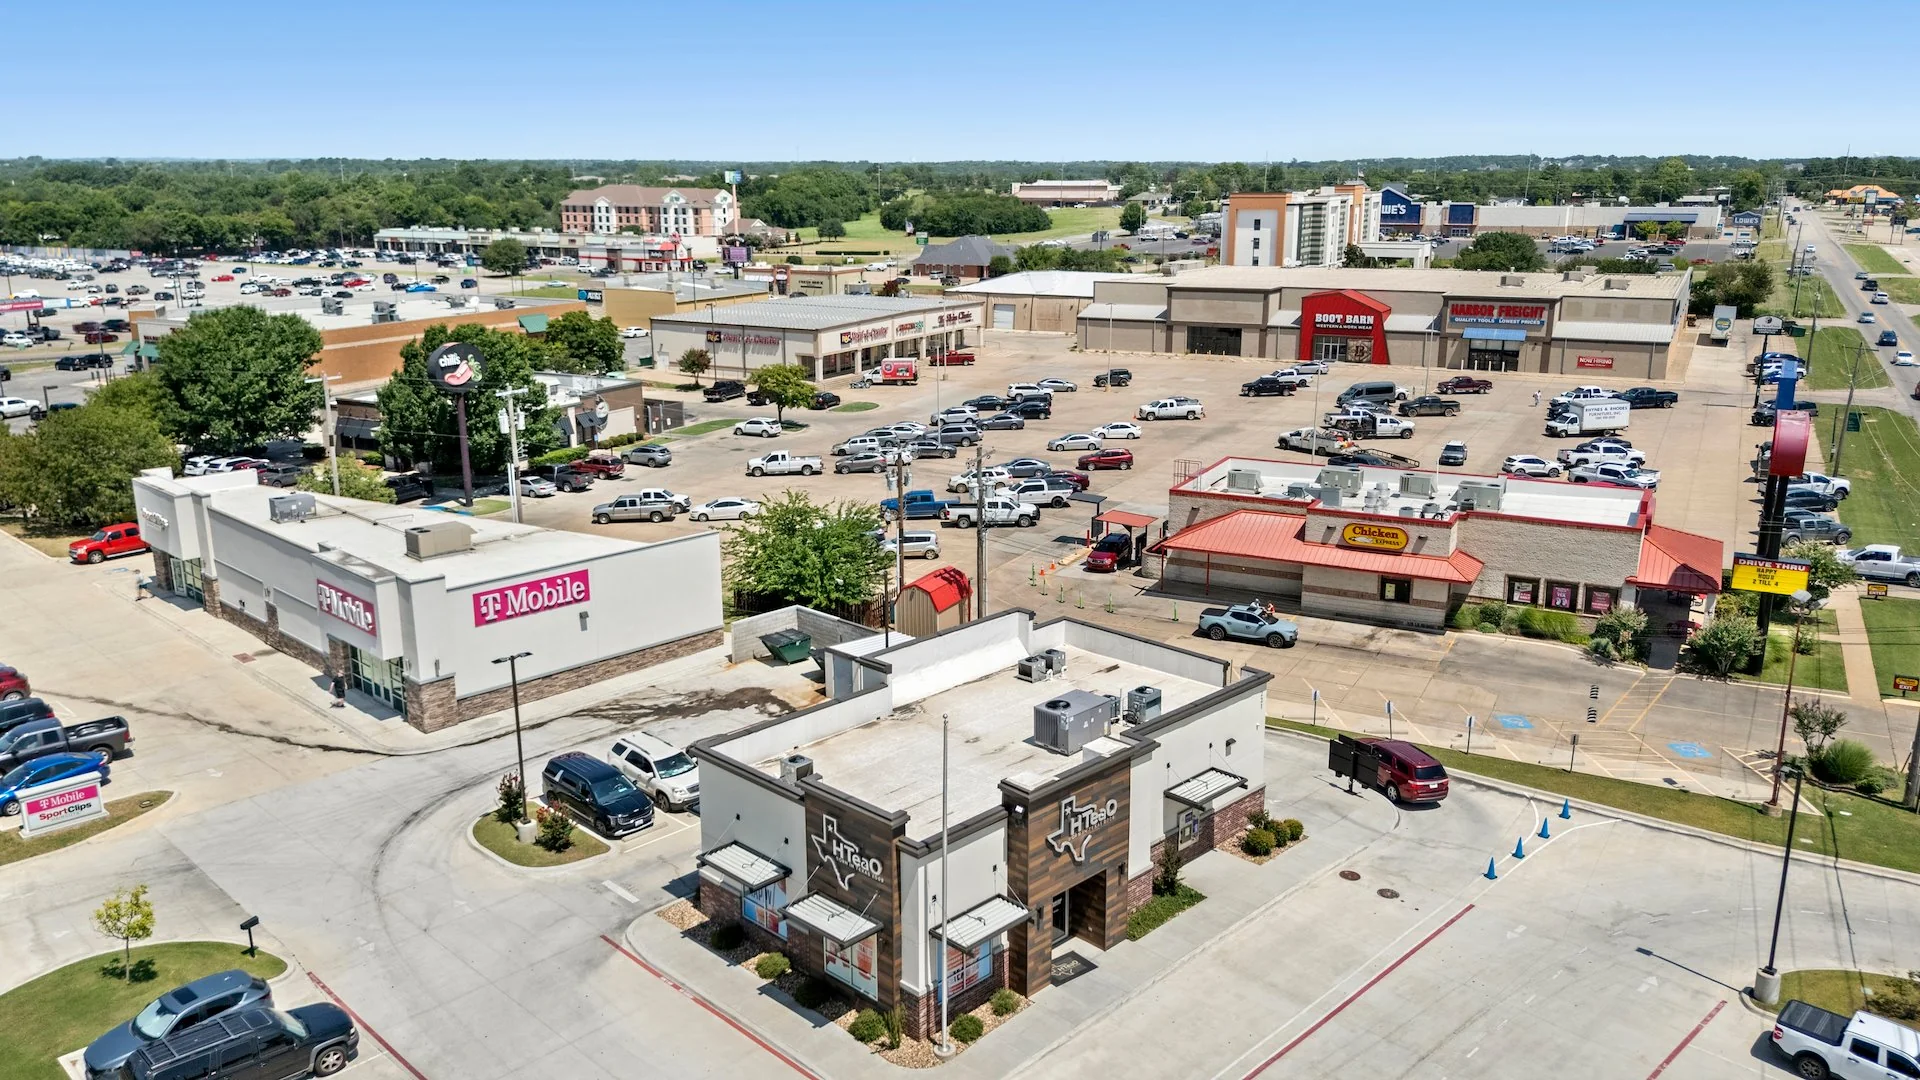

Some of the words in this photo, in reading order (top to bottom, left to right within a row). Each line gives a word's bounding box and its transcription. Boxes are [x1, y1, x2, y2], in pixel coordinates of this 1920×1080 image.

[1315, 313, 1343, 323] BOOT
[1346, 314, 1374, 324] BARN
[1450, 304, 1495, 317] HARBOR
[1497, 306, 1545, 318] FREIGHT
[1352, 526, 1398, 539] Chicken
[1739, 559, 1772, 567] DRIVE
[504, 577, 585, 616] Mobile
[330, 588, 373, 631] Mobile
[51, 791, 85, 807] Mobile
[1070, 799, 1118, 836] HTeaO
[833, 839, 883, 876] HTeaO
